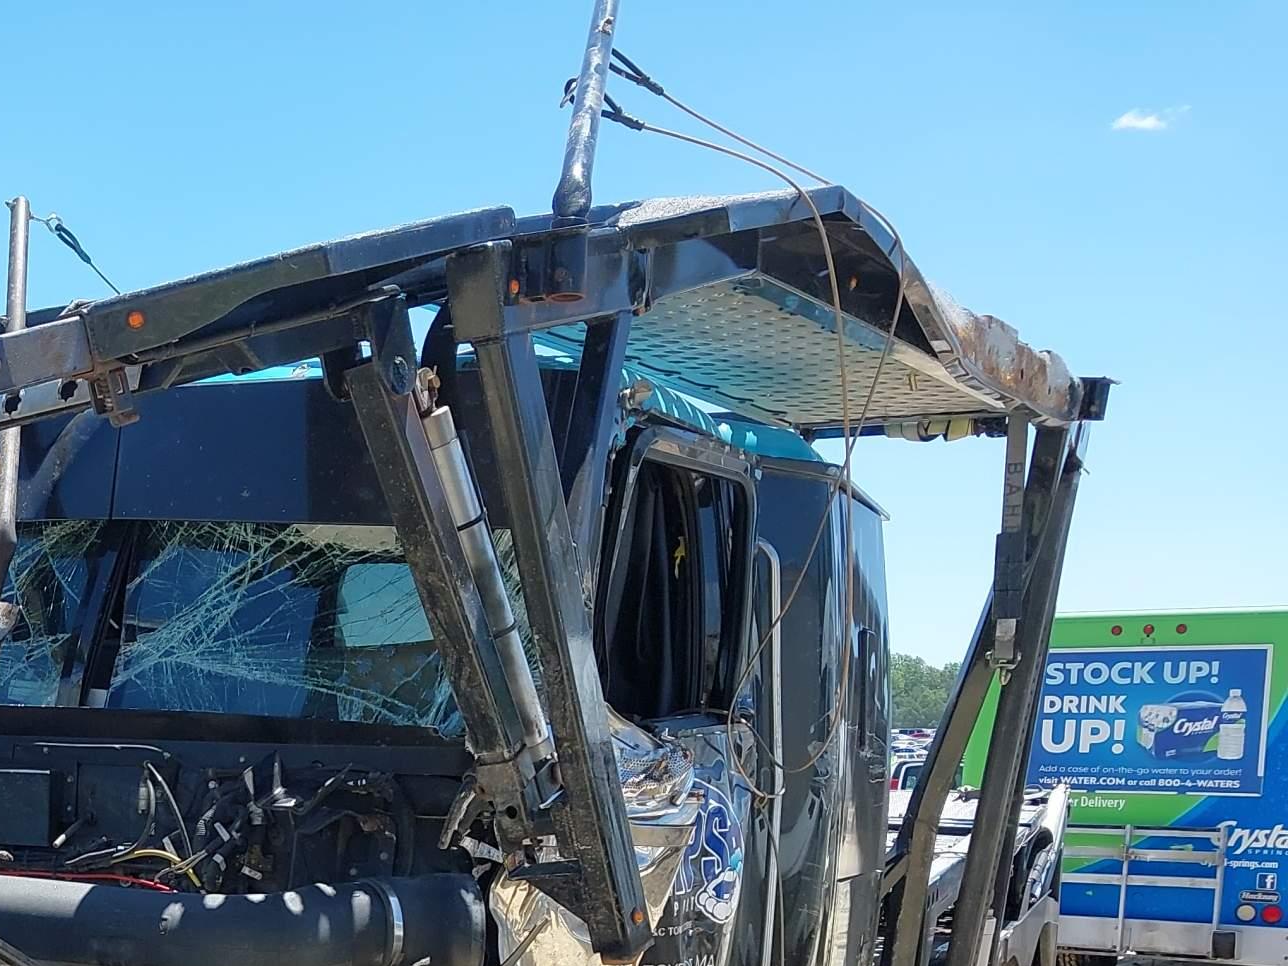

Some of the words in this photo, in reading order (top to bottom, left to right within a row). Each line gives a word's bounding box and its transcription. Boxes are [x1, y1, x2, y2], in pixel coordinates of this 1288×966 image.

[1045, 661, 1156, 685] STOCK
[1163, 661, 1220, 684] UP!
[1043, 695, 1127, 714] DRINK
[1173, 715, 1220, 736] Crystal
[1041, 719, 1126, 755] UP!
[1038, 765, 1058, 773] Add
[1090, 765, 1100, 773] of
[1102, 766, 1150, 776] on-the-go
[1190, 769, 1213, 777] your
[1214, 768, 1243, 776] order!
[1038, 776, 1058, 784] visit
[1060, 776, 1126, 786] WATER.COM
[1158, 778, 1241, 789] 800-4-WATERS
[1080, 796, 1126, 811] Delivery
